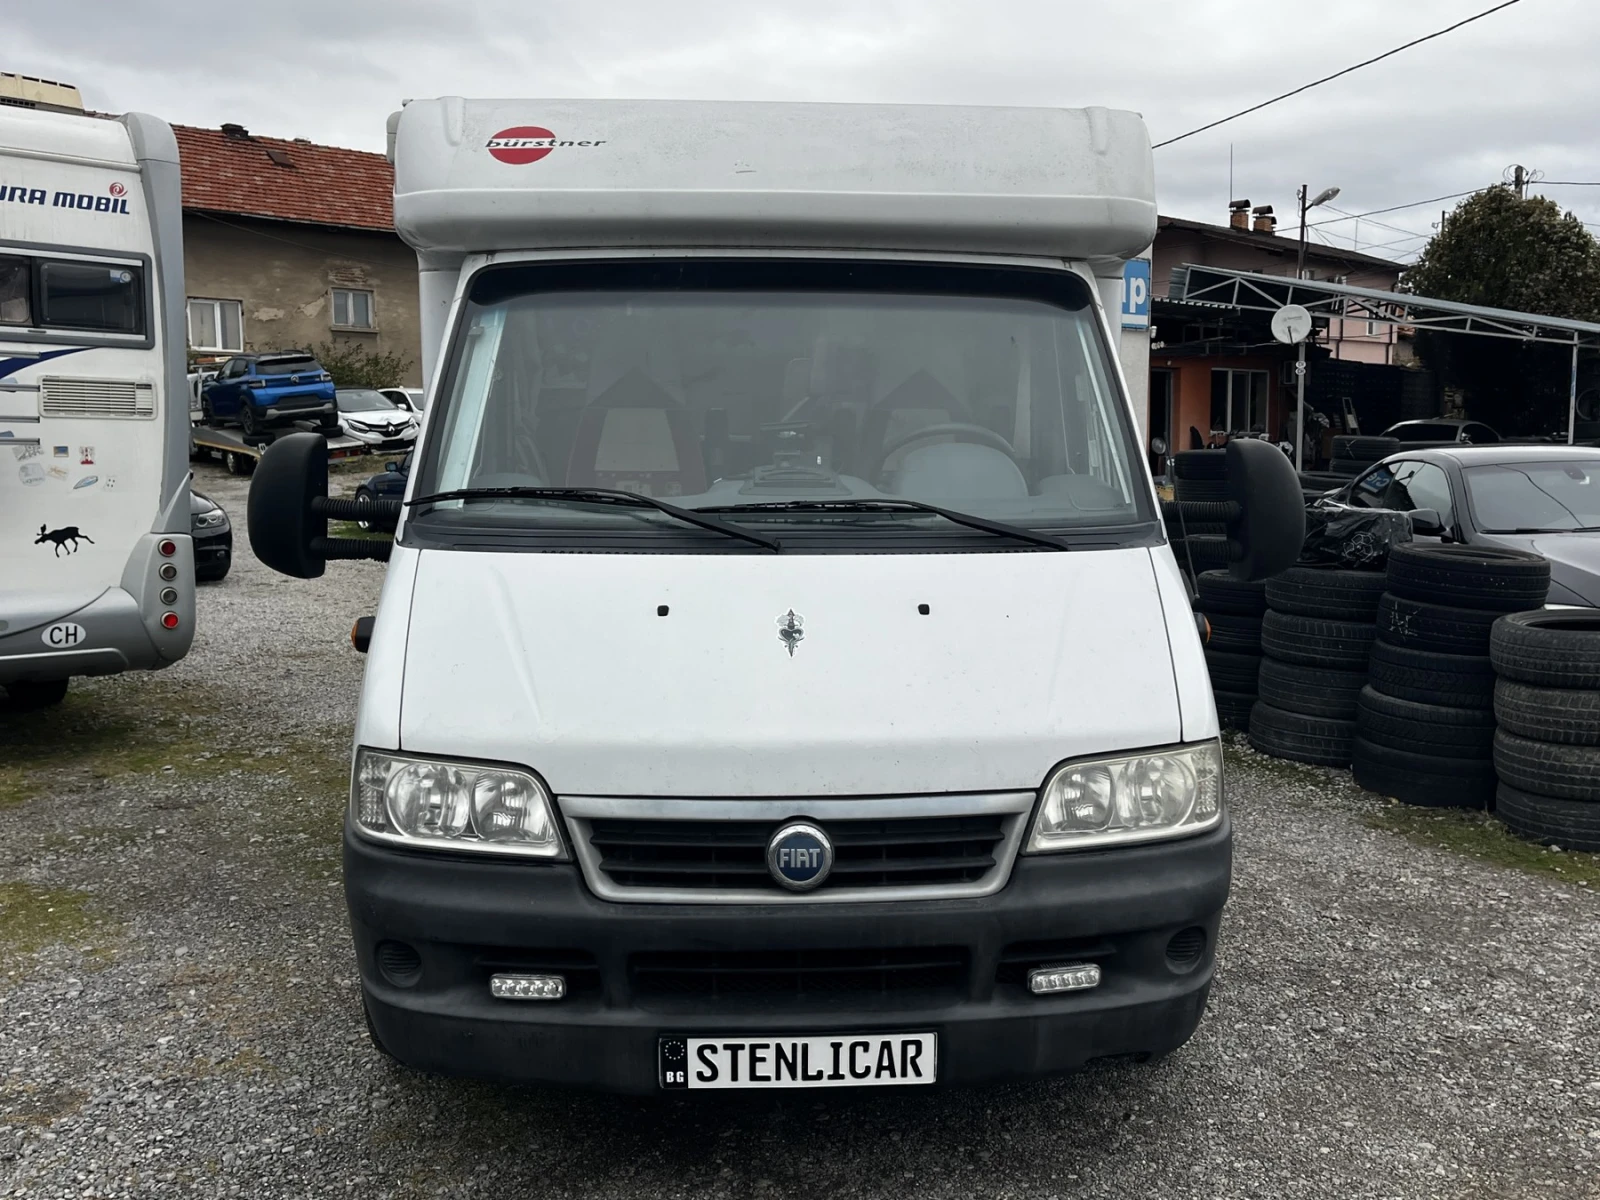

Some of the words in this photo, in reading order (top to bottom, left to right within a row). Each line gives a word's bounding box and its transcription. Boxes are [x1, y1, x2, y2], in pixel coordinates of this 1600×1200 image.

[485, 139, 607, 148] bürstner
[52, 192, 130, 215] MOBIL
[50, 625, 78, 644] CH
[780, 848, 820, 868] FIAT
[666, 1071, 684, 1083] BG
[696, 1039, 923, 1082] STENLICAR
